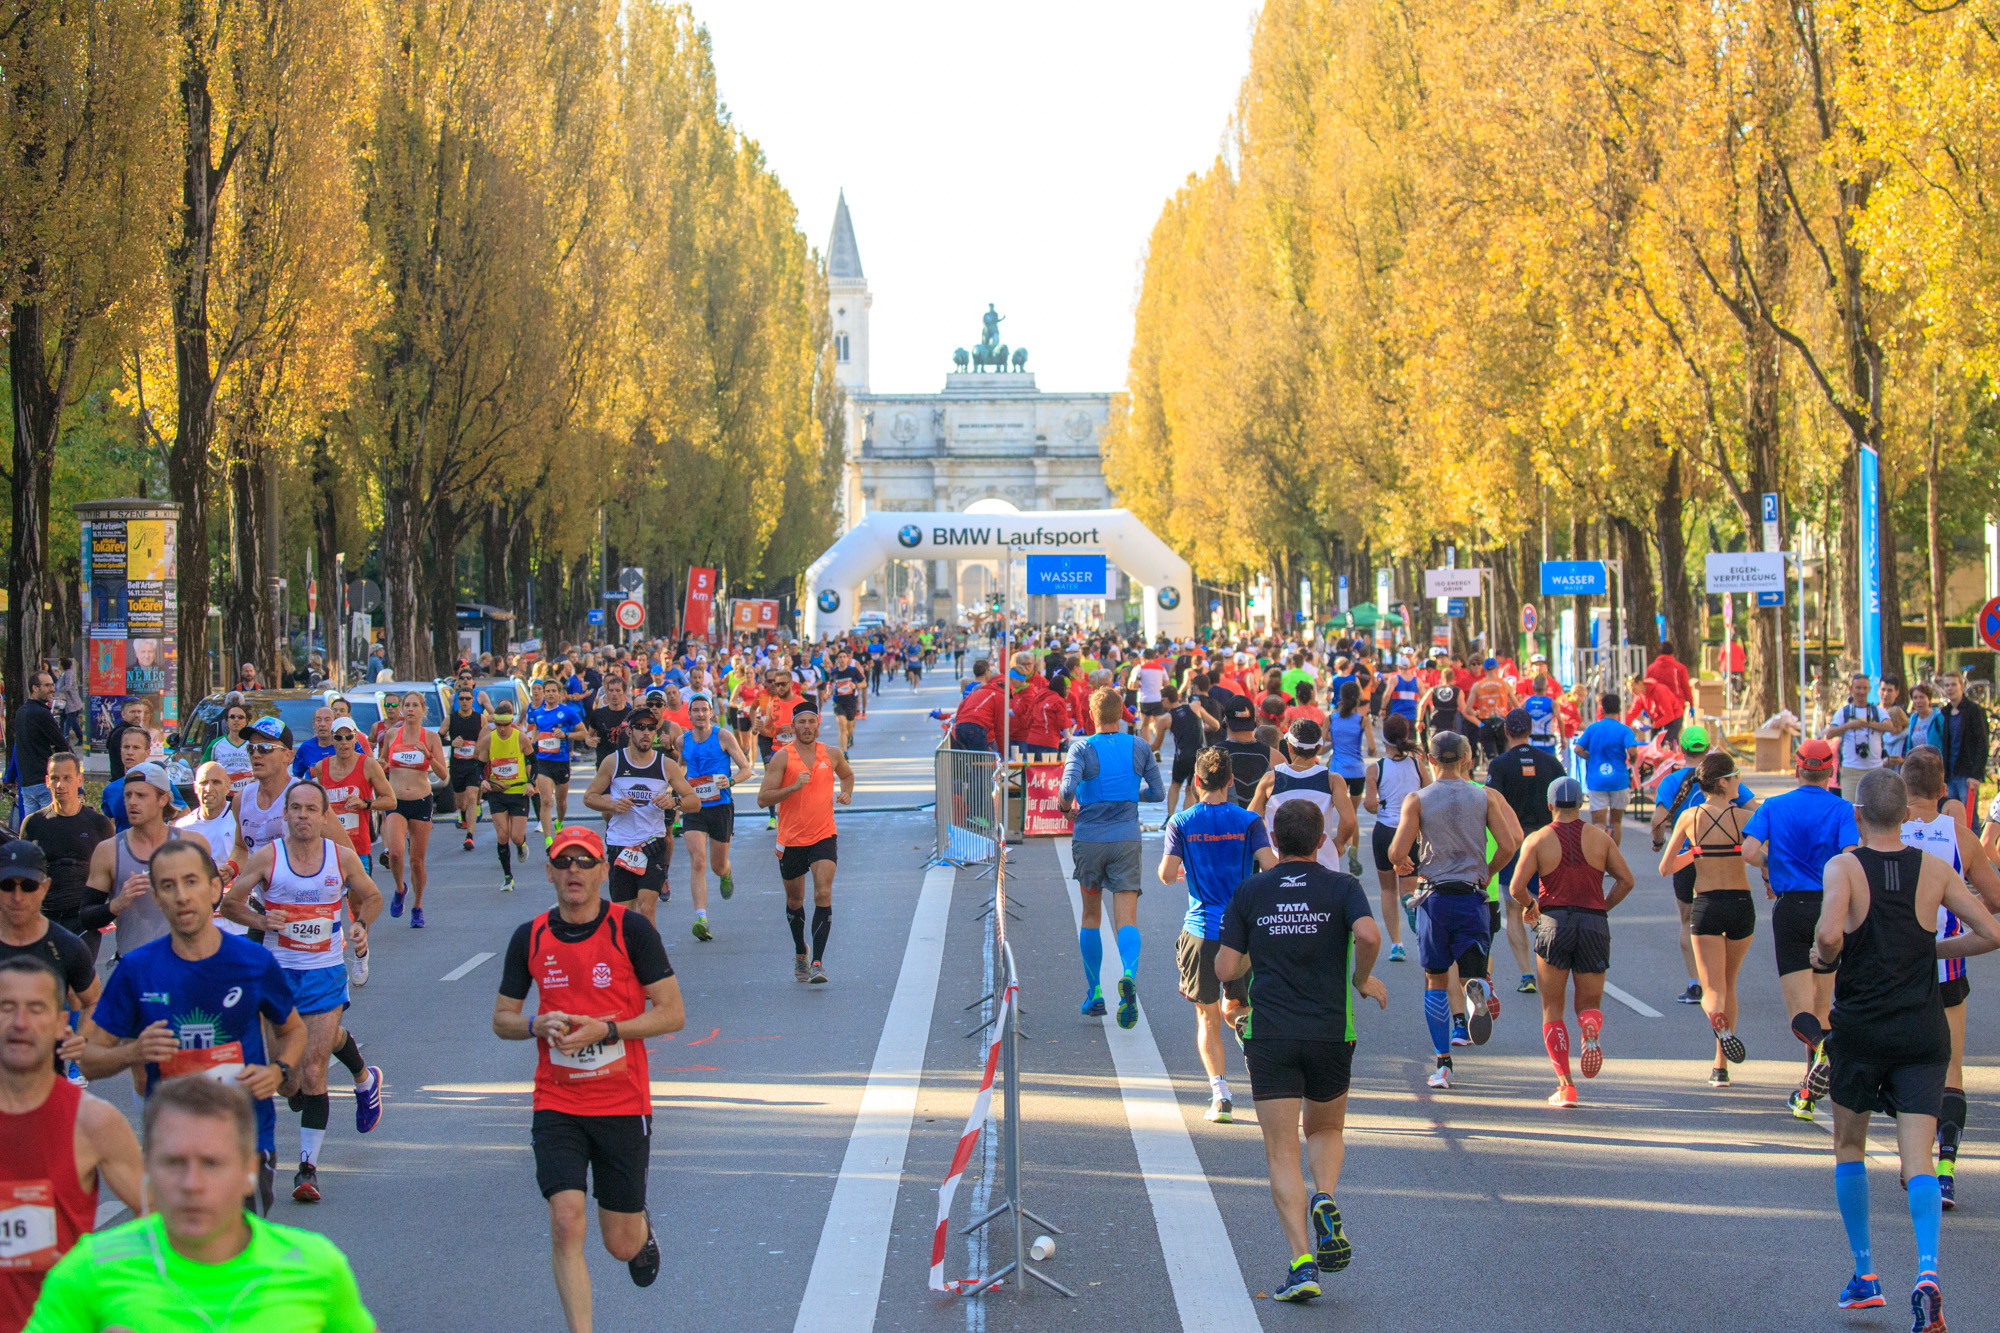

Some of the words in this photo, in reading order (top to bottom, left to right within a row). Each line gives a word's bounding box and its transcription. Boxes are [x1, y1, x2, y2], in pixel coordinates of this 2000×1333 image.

[1764, 497, 1774, 520] P
[933, 527, 991, 546] BMW
[997, 527, 1099, 547] Laufsport
[92, 541, 126, 553] Tokarev
[1730, 566, 1760, 574] EIGEN-
[698, 574, 707, 588] 5
[1040, 571, 1093, 582] WASSER
[1551, 575, 1595, 584] WASSER
[1713, 573, 1777, 582] VERPFLEGUNG
[692, 589, 708, 601] km
[127, 599, 163, 612] Tokarev
[741, 607, 752, 623] 5
[762, 606, 772, 620] 5
[126, 670, 165, 681] NEMEC
[400, 752, 417, 760] 2097
[627, 791, 653, 800] SNOOZE
[695, 786, 712, 794] 6238
[1033, 815, 1069, 830] Altenmarkt
[1187, 835, 1202, 843] UTC
[1203, 832, 1245, 842] Esternberg
[1276, 903, 1310, 912] TATA
[1256, 913, 1331, 926] CONSULTANCY
[292, 923, 320, 935] 5246
[1268, 924, 1318, 935] SERVICES
[543, 975, 569, 984] BEAmed
[569, 1071, 597, 1079] MARATHON
[598, 1068, 610, 1076] 2018
